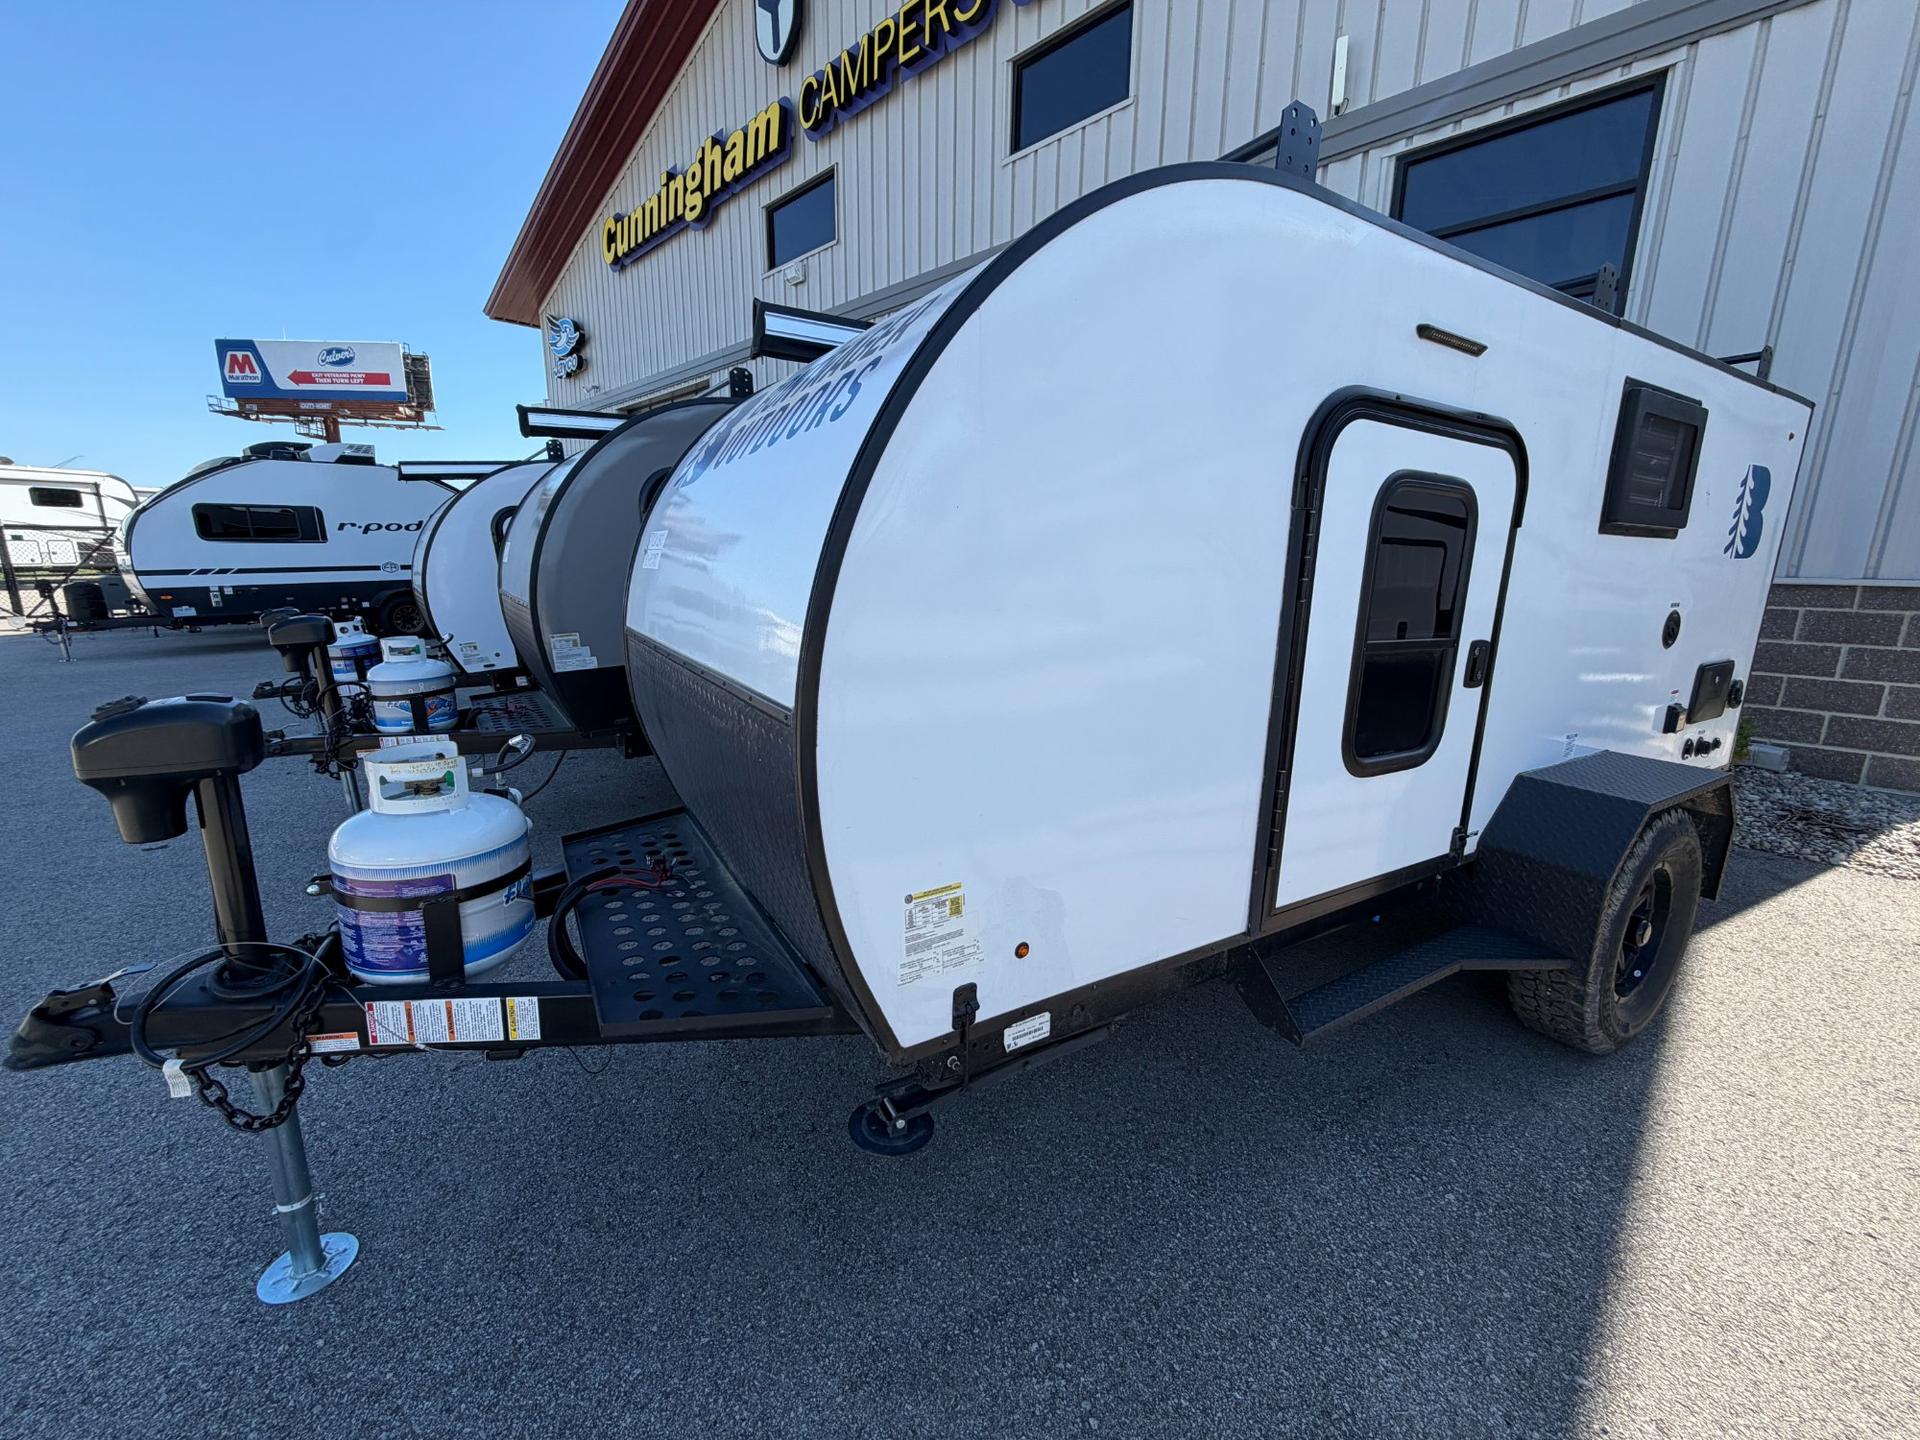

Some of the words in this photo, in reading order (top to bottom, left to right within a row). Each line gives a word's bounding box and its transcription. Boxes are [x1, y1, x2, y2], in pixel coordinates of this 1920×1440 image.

[602, 102, 781, 265] Cunningham
[229, 353, 257, 374] M
[318, 346, 355, 366] Culver's
[553, 354, 578, 379] Jayco
[713, 355, 883, 470] OUTDOORS
[369, 1010, 377, 1031] DANGER
